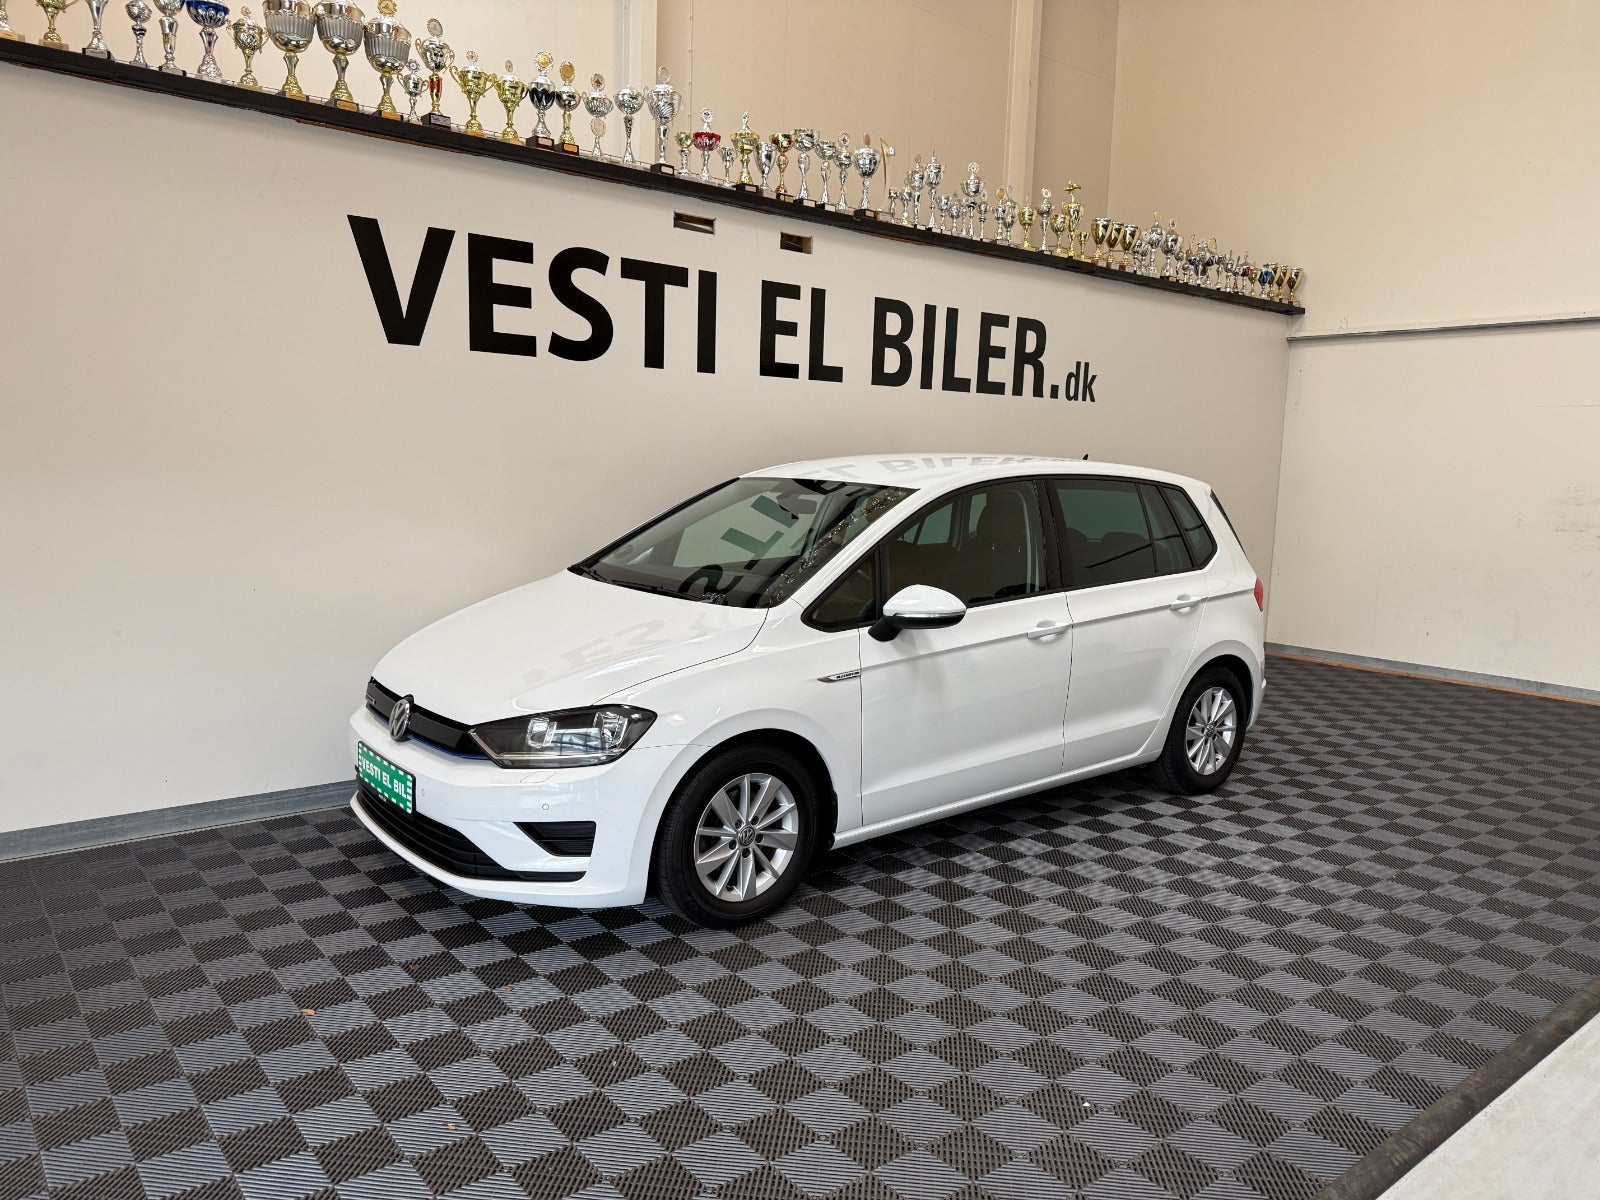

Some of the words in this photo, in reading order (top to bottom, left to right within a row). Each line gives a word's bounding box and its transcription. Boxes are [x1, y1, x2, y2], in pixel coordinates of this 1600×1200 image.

[346, 214, 718, 375] VESTI
[759, 279, 844, 383] EL
[361, 756, 381, 781] VESTI
[382, 771, 392, 789] EL
[393, 778, 407, 799] BIL
